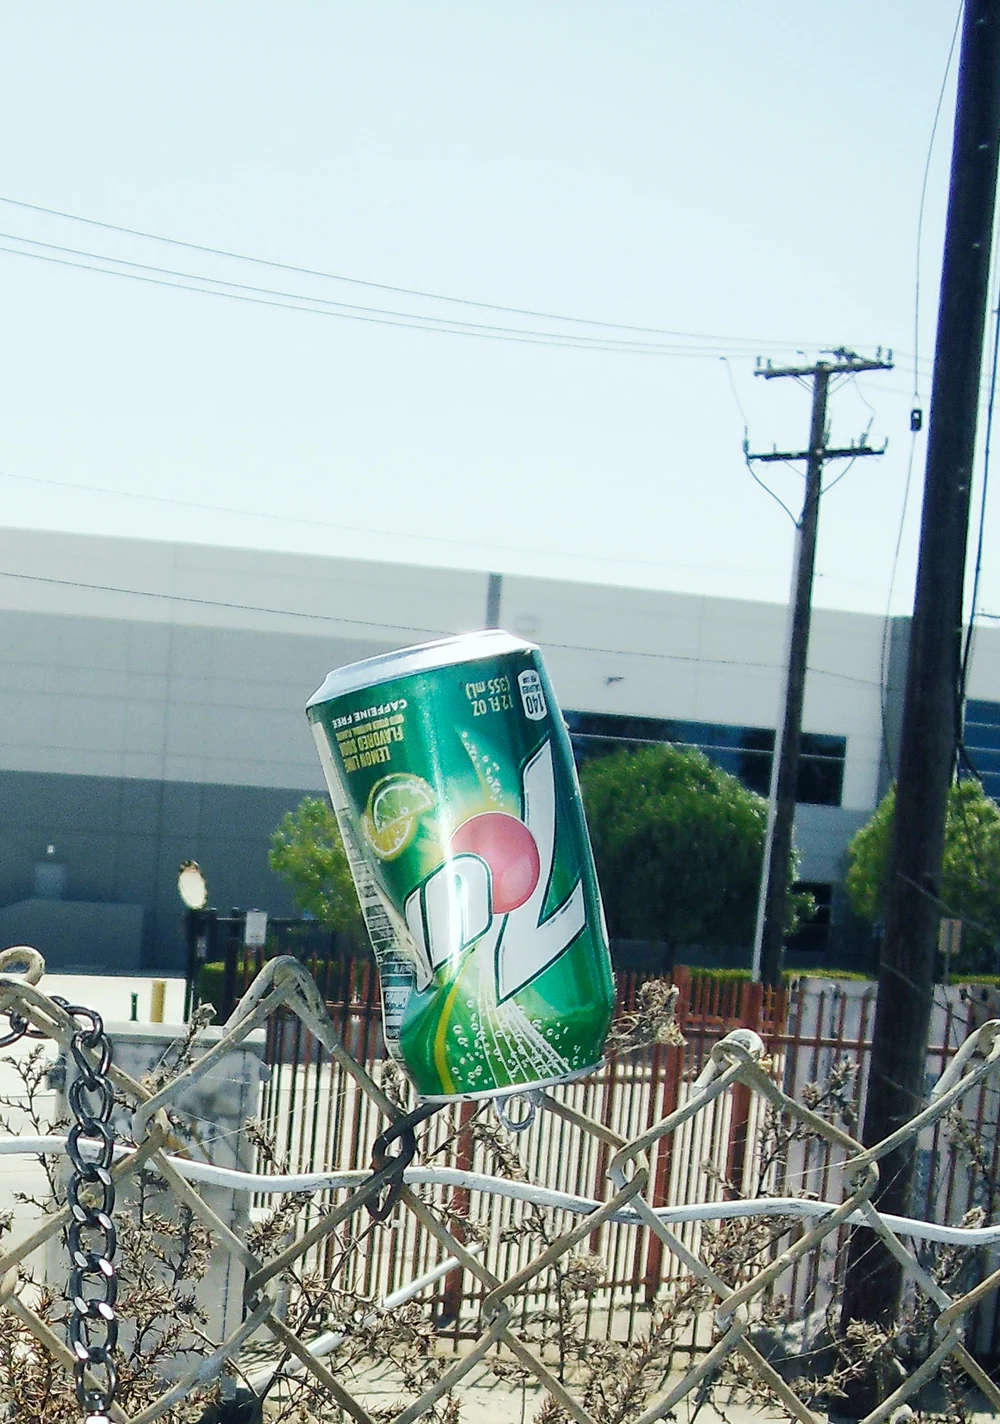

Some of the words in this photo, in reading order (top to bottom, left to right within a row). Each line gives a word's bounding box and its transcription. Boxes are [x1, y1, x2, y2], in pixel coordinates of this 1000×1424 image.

[464, 681, 486, 700] mL)
[353, 699, 408, 721] CAFFEINE
[471, 699, 487, 717] OZ
[488, 696, 501, 712] FL
[501, 694, 514, 710] 12
[525, 693, 544, 714] 140
[331, 714, 353, 729] FREE
[357, 725, 405, 751] FLAVORED
[359, 746, 391, 767] LEMON
